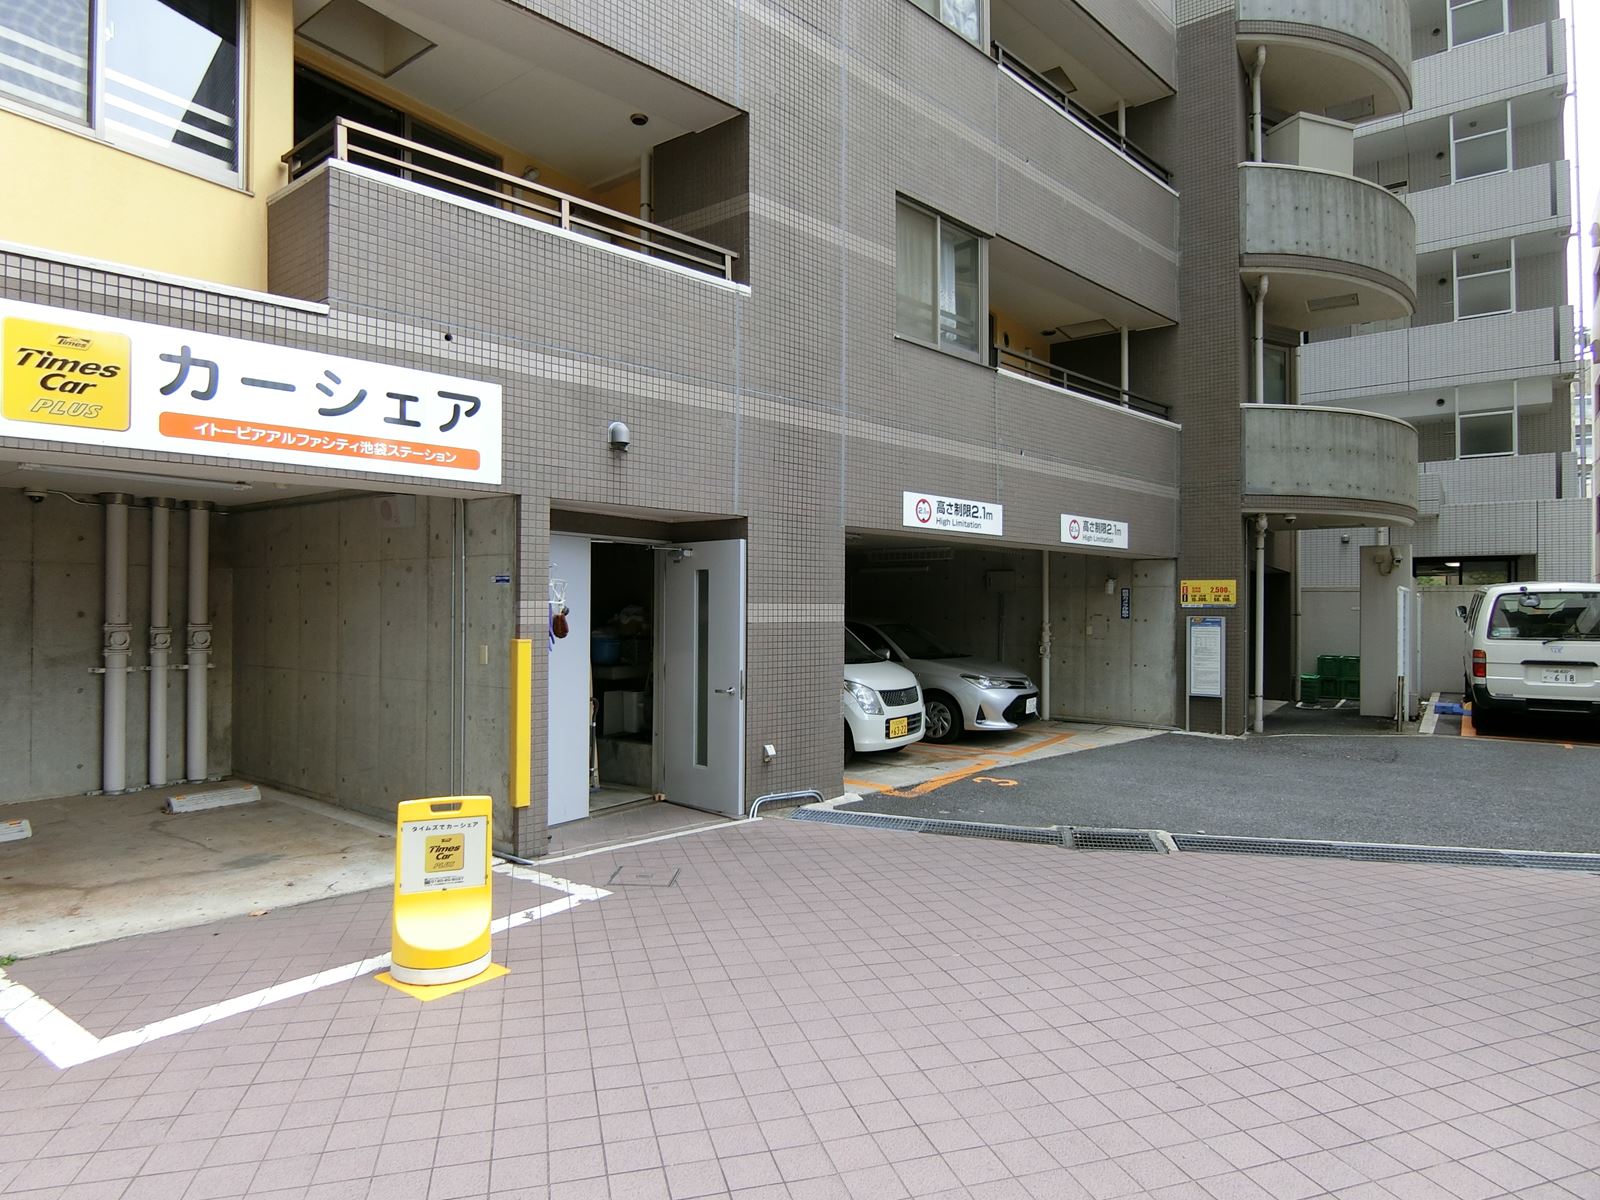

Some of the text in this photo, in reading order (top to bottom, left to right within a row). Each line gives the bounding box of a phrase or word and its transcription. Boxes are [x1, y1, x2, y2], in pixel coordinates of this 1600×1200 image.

[56, 335, 90, 348] Times
[17, 347, 121, 378] Times
[40, 373, 97, 394] Car
[159, 345, 481, 432] カーシェア
[31, 398, 103, 418] PLUS
[193, 421, 457, 463] イトーピアアルファシティ池袋ステーション
[936, 500, 993, 521] 高さ制限2.1m
[936, 517, 982, 529] High Limitation
[429, 845, 461, 853] Times
